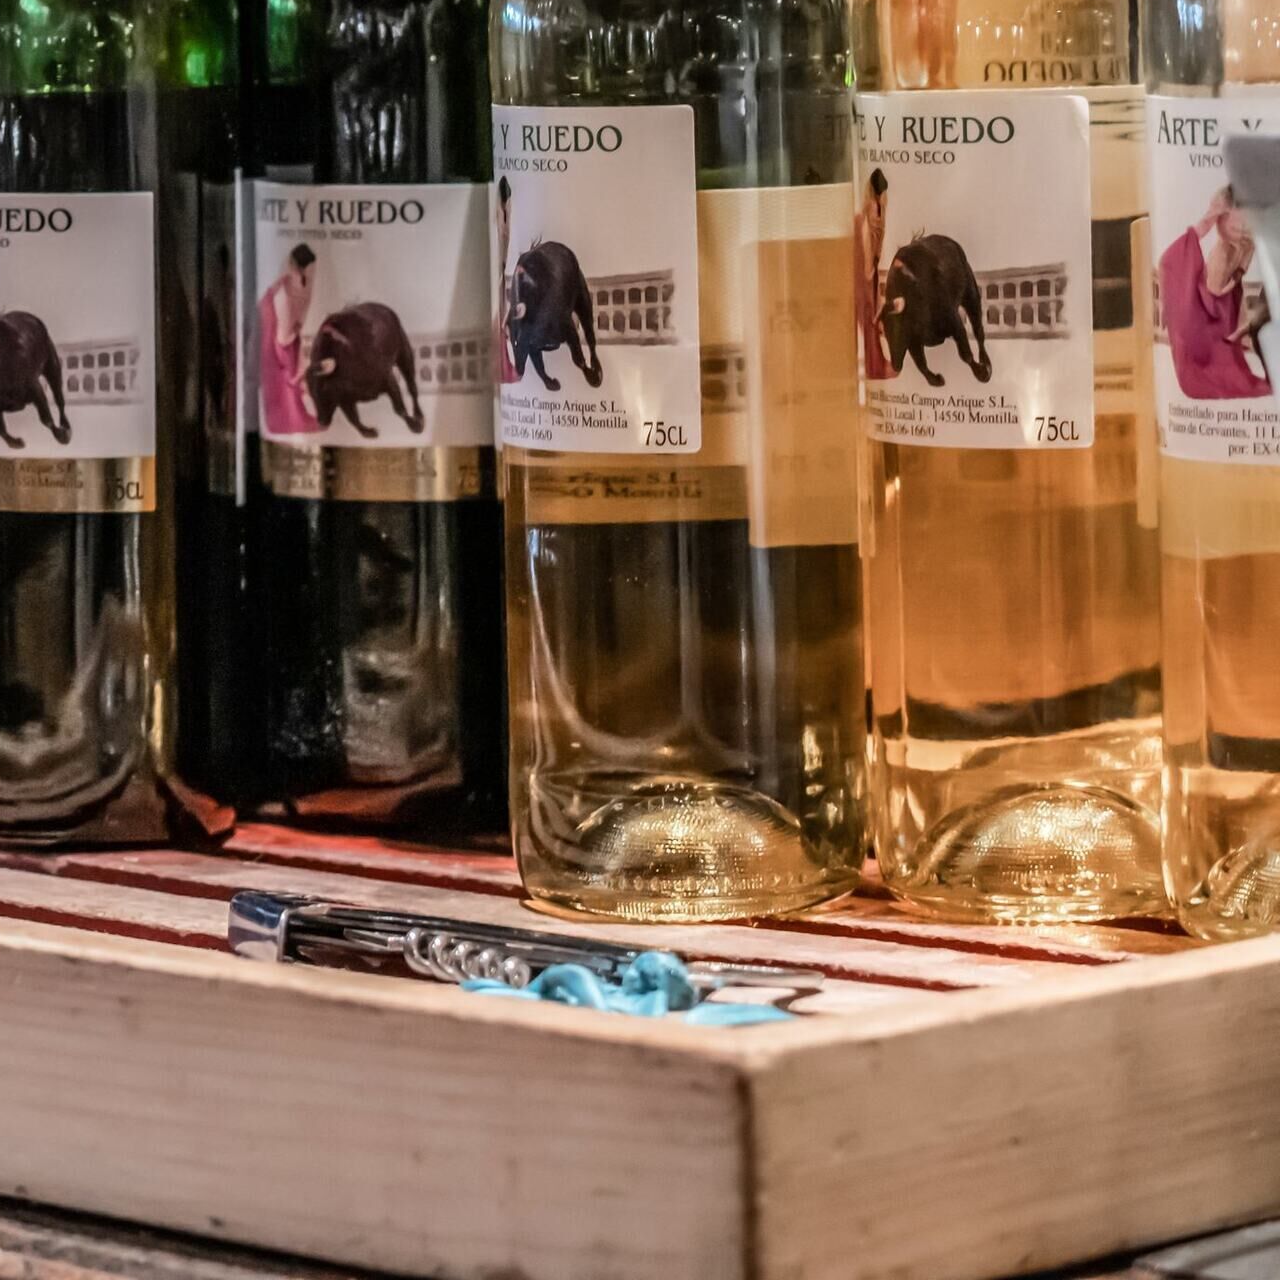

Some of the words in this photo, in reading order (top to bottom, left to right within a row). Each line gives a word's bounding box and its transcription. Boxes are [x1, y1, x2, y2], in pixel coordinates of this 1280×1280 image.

[500, 124, 509, 151] Y
[522, 124, 623, 152] RUEDO
[875, 116, 886, 143] Y
[902, 116, 1015, 145] RUEDO
[1157, 109, 1220, 147] ARTE
[532, 158, 568, 173] SECO
[870, 149, 910, 163] BLANCO
[914, 150, 956, 165] SECO
[1189, 153, 1223, 168] VINO
[296, 200, 310, 223] Y
[319, 199, 425, 225] RUEDO
[532, 397, 561, 414] Campo
[563, 400, 597, 416] Arique
[911, 393, 945, 410] Campo
[947, 396, 985, 412] Arique
[517, 410, 536, 425] Local
[551, 414, 579, 427] 14550
[581, 416, 628, 430] Montilla
[894, 407, 916, 421] Local
[934, 411, 965, 423] 14550
[969, 411, 1018, 425] Montilla
[643, 420, 688, 447] 75CL
[1035, 416, 1080, 442] 75CL
